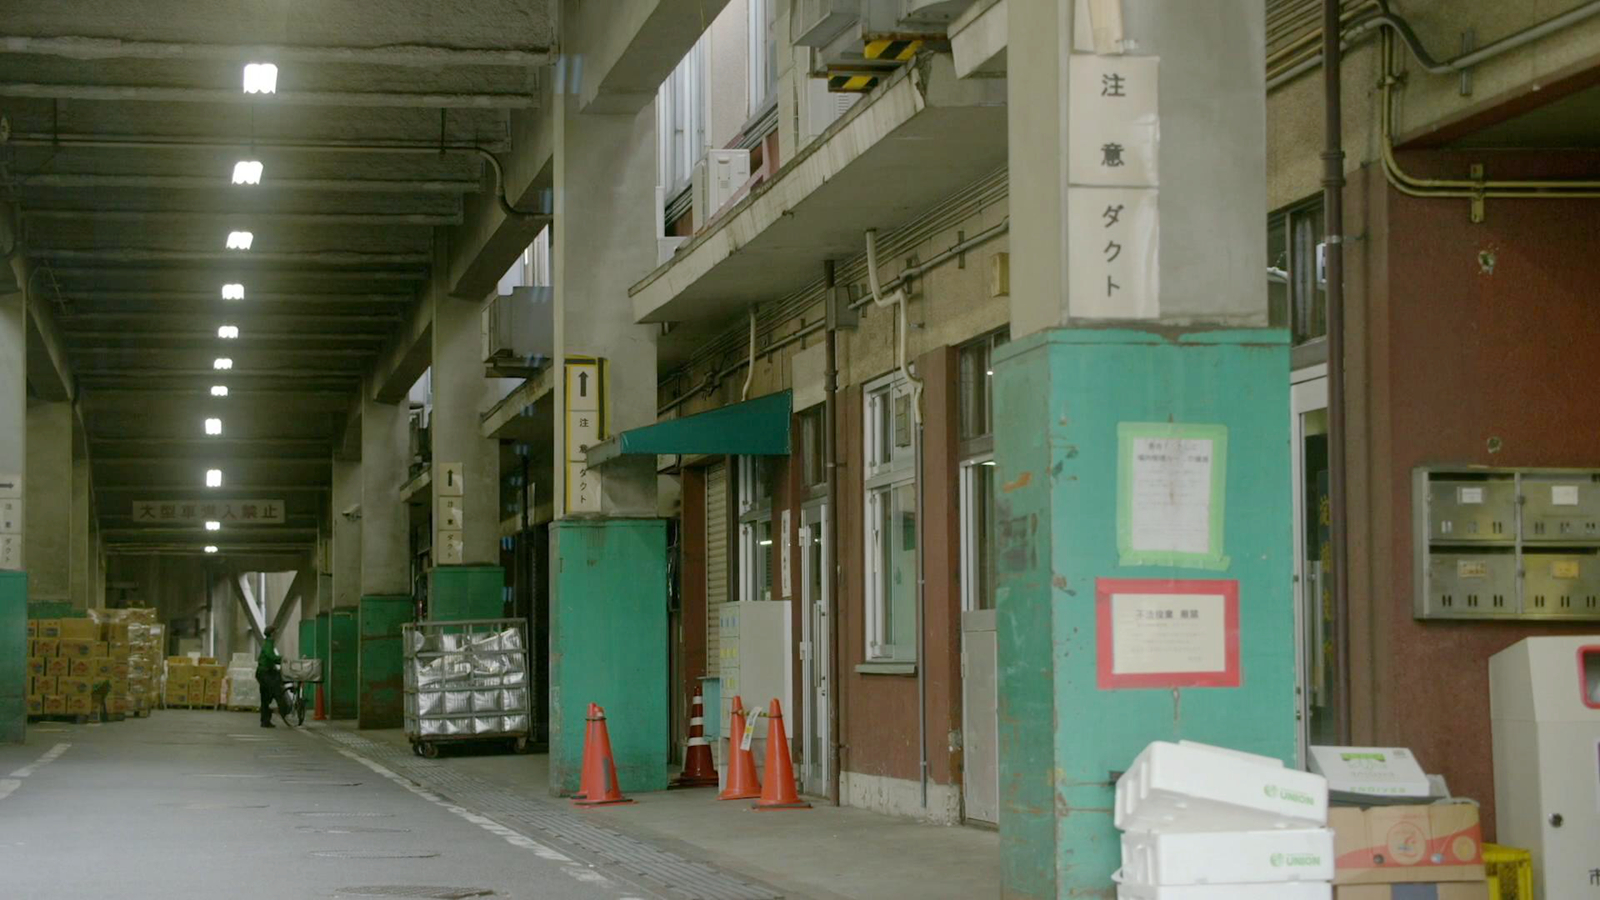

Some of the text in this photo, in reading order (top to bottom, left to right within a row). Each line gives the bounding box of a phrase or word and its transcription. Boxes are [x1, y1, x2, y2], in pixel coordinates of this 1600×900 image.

[1101, 73, 1126, 298] 注意 ダクト
[1280, 789, 1314, 806] UNION
[1286, 856, 1321, 867] UNION
